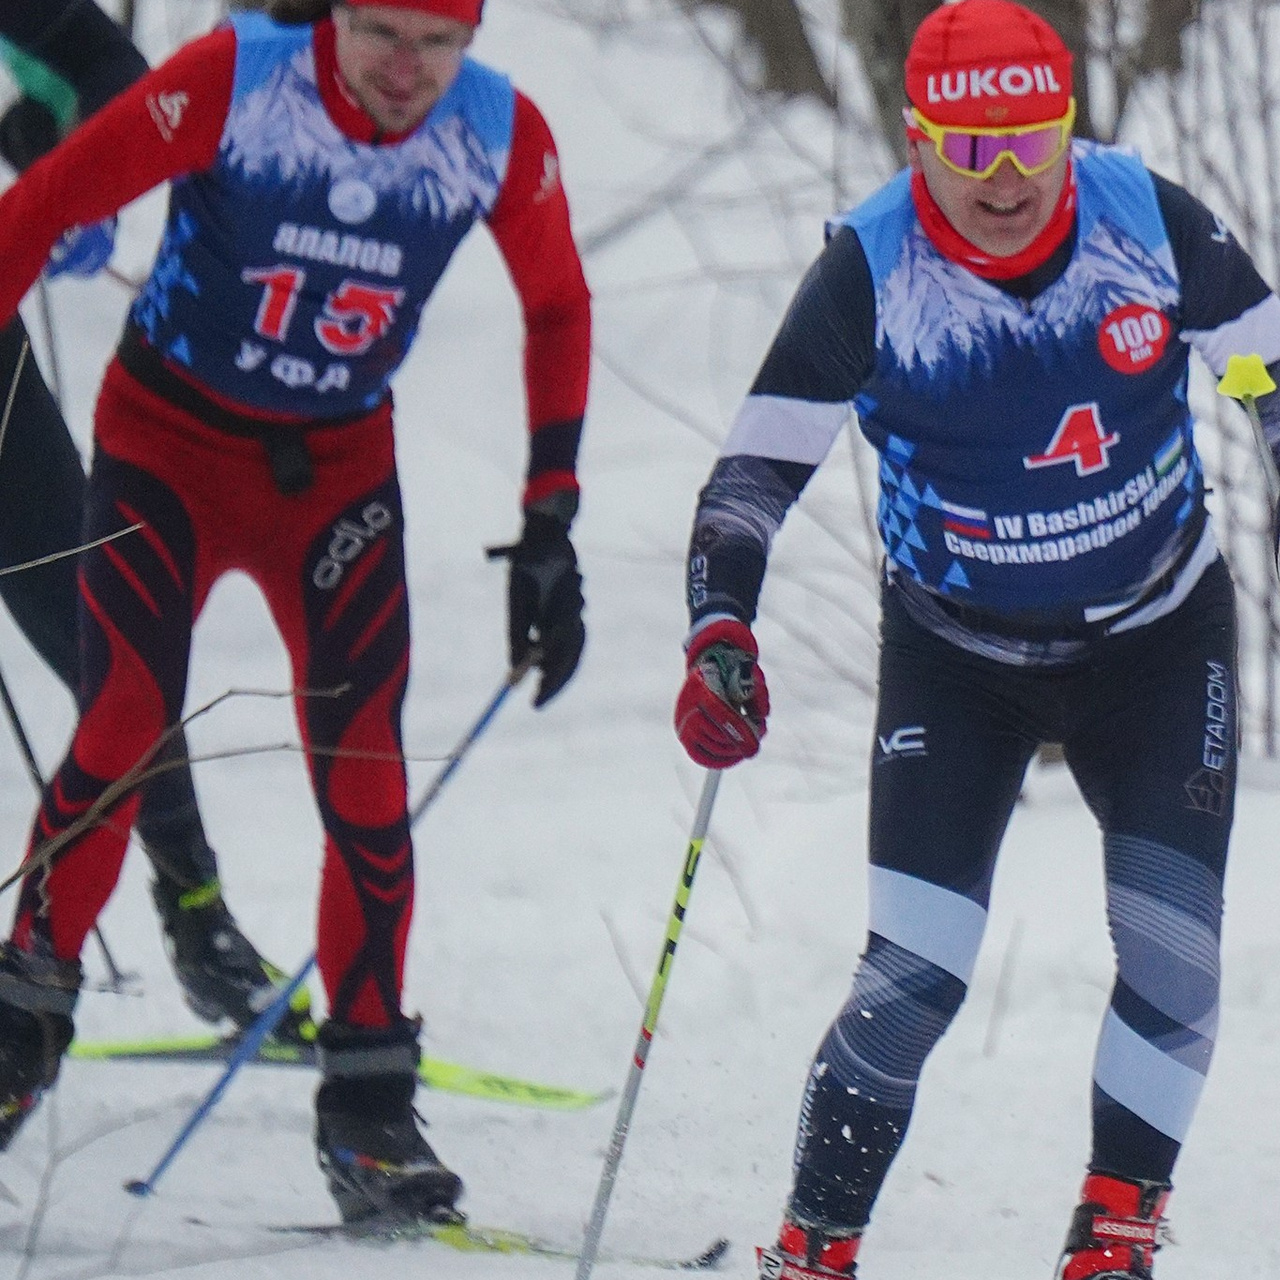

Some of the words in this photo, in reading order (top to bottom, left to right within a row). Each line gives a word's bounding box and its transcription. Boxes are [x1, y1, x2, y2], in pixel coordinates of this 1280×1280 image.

[927, 65, 1061, 104] LUKOIL
[240, 263, 407, 356] 15
[1105, 311, 1164, 354] 100
[234, 340, 351, 393] УФА
[1023, 401, 1121, 477] 4
[943, 506, 1142, 565] Сверхмарафон
[993, 515, 1024, 540] IV
[1026, 465, 1156, 538] BashkirSki
[1203, 659, 1227, 770] ETADOM
